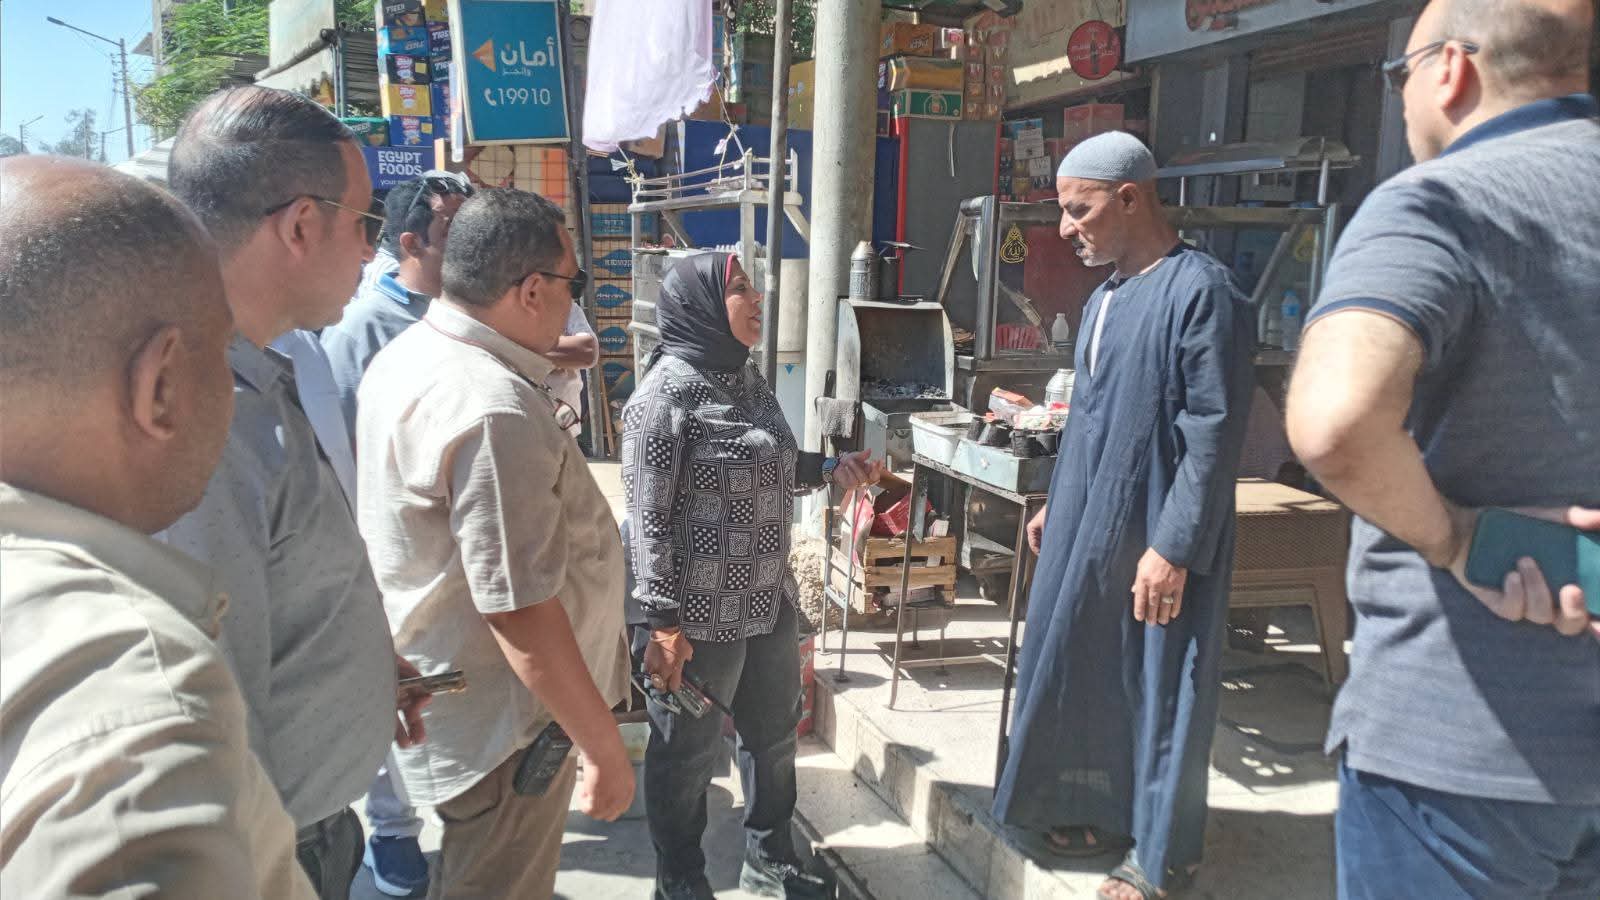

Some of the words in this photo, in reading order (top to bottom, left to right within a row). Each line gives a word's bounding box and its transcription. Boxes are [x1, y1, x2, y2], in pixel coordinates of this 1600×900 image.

[500, 36, 556, 67] أمان
[498, 87, 551, 105] 19910
[377, 150, 423, 164] EGYPT
[378, 162, 422, 176] FOODS
